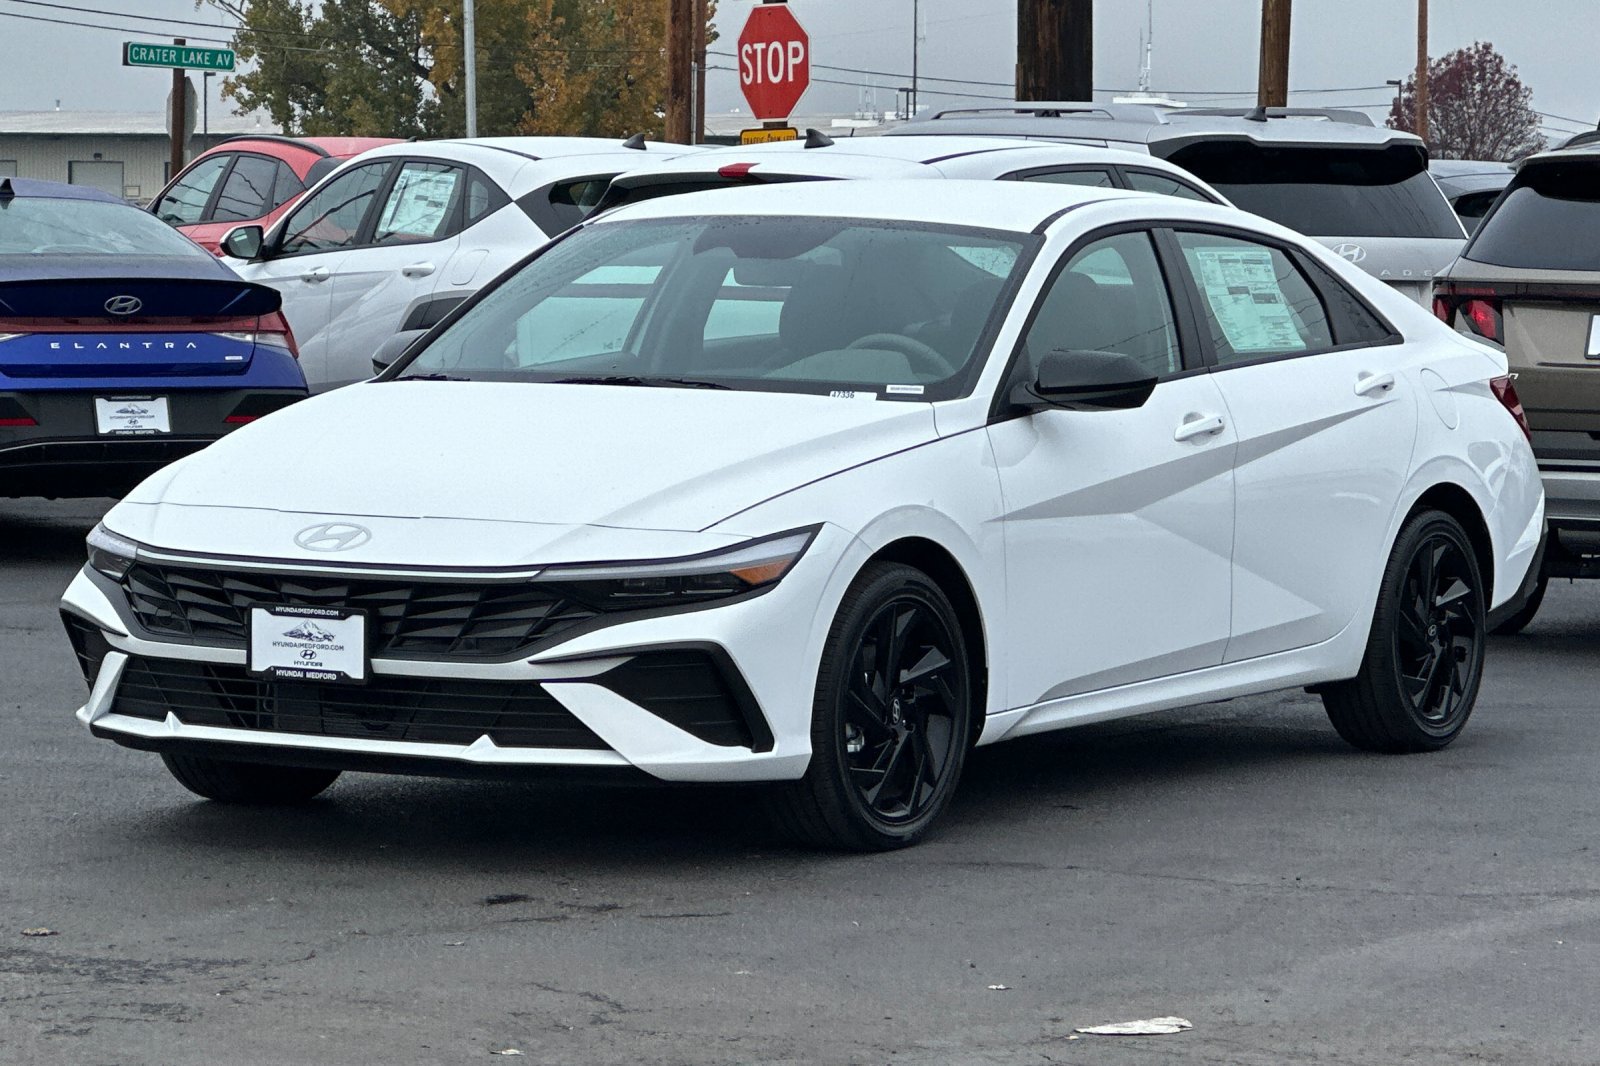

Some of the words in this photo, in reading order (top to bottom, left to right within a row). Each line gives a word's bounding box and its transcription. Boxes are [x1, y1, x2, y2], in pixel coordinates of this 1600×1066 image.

[132, 47, 176, 63] CRATER
[182, 51, 211, 65] LAKE
[216, 54, 231, 66] AV
[741, 40, 805, 85] STOP
[275, 606, 339, 616] HYUNDAIMEDFORD.COM
[272, 641, 345, 651] HYUNDAIMEDFORD.COM
[276, 669, 304, 678] HYUNDAI
[306, 671, 337, 680] MEDFORD
